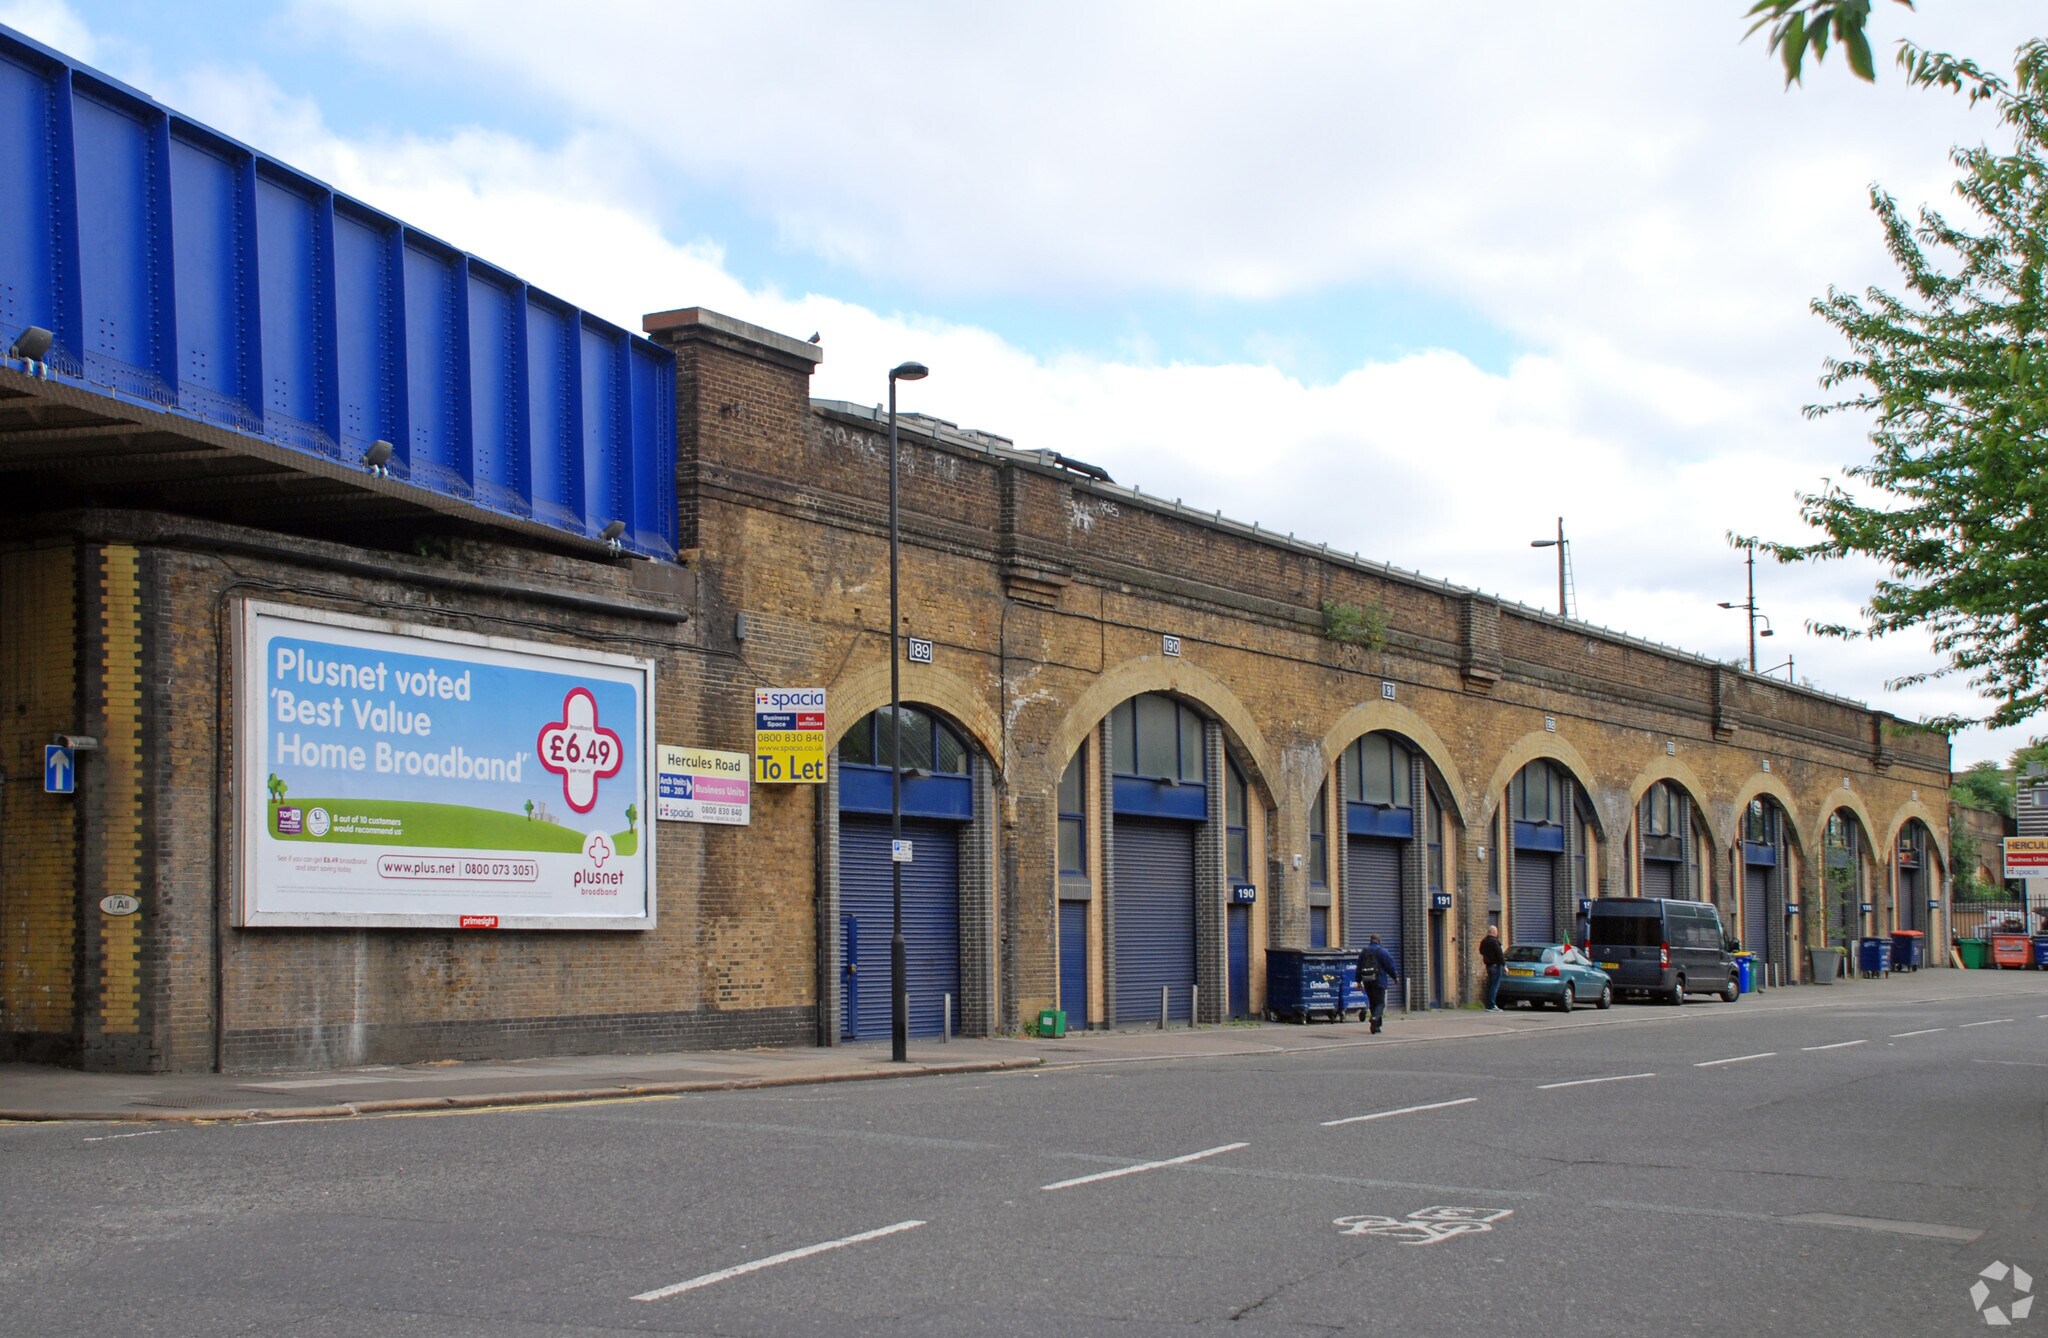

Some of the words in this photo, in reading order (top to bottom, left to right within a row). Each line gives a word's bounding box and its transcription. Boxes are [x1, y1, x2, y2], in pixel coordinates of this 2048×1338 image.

[911, 642, 929, 658] 189
[1165, 639, 1179, 653] 190
[277, 647, 388, 692] Plusnet
[395, 668, 471, 701] voted
[771, 690, 824, 711] spacia
[352, 698, 431, 736] Value
[757, 733, 781, 742] 0800
[785, 733, 803, 742] 830
[806, 733, 824, 742] 840
[277, 732, 366, 771] Home
[550, 733, 610, 766] £6.49
[668, 753, 712, 769] Hercules
[715, 758, 741, 772] Road
[757, 755, 781, 779] To
[790, 755, 823, 780] Let
[660, 777, 672, 785] Arch
[673, 778, 686, 786] Units
[695, 784, 725, 795] Business
[727, 787, 745, 796] Units
[279, 811, 291, 819] TOP
[670, 808, 693, 819] spacia
[701, 806, 716, 814] 0800
[718, 807, 730, 815] 830
[731, 808, 742, 816] 840
[339, 816, 350, 824] out
[351, 816, 359, 824] of
[360, 816, 367, 824] 10
[368, 817, 401, 826] customers
[333, 825, 354, 833] would
[355, 826, 393, 835] recommend
[2007, 841, 2048, 849] HERCUL
[320, 866, 336, 874] saving
[384, 860, 455, 875] www.plus.net
[465, 863, 490, 875] 0800
[492, 864, 510, 875] 073
[512, 865, 534, 876] 3051
[573, 869, 624, 887] plusnet
[581, 888, 617, 896] broadband
[1238, 888, 1254, 899] 190
[1437, 896, 1450, 905] 191
[463, 916, 495, 927] primesight
